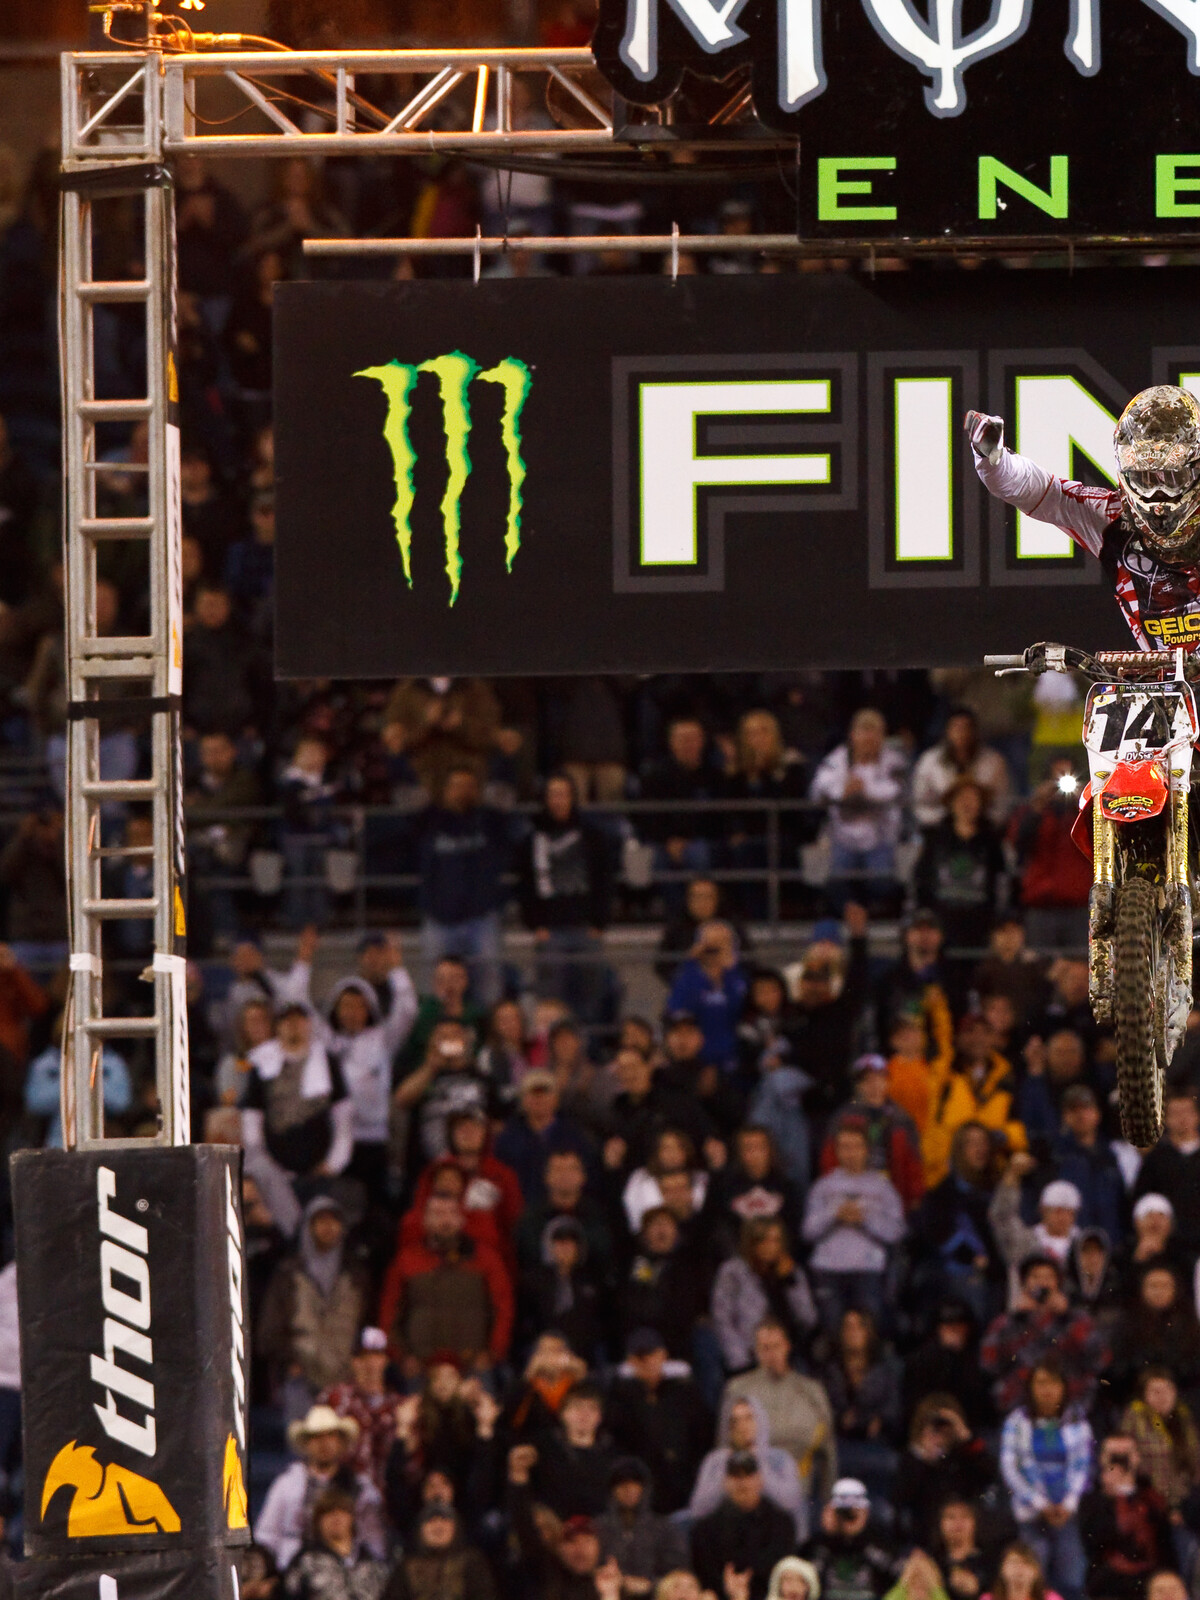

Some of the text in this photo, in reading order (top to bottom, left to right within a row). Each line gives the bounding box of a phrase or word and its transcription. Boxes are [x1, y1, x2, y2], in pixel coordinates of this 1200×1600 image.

[1095, 695, 1177, 752] 14
[1108, 796, 1154, 808] GEICO
[90, 1166, 156, 1457] thor
